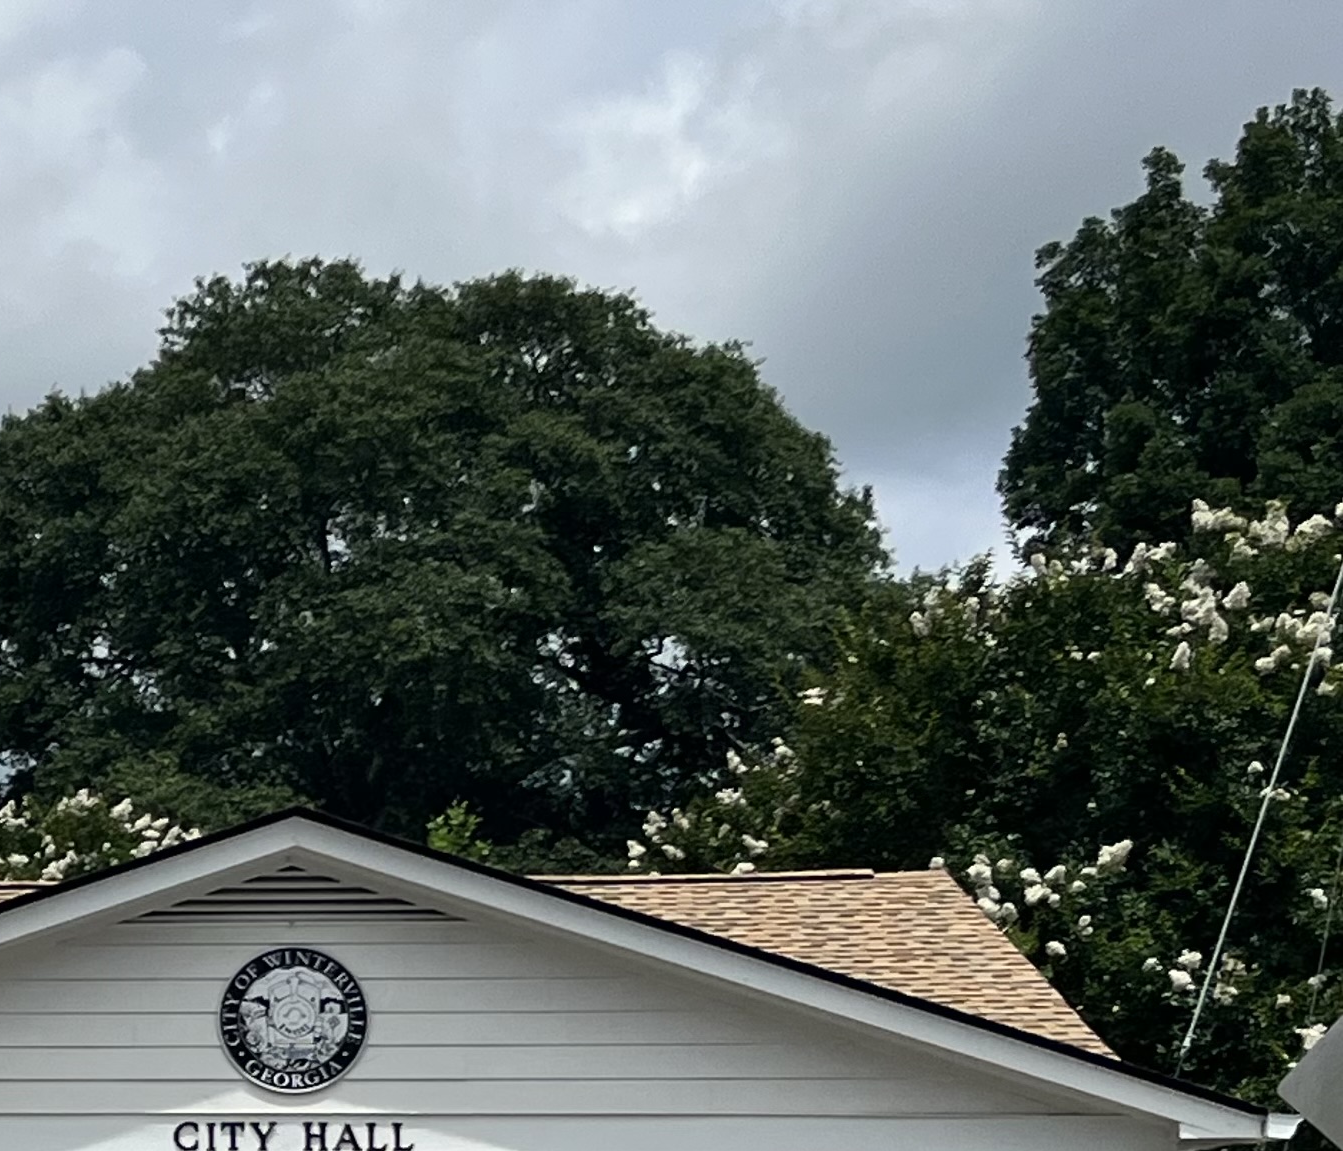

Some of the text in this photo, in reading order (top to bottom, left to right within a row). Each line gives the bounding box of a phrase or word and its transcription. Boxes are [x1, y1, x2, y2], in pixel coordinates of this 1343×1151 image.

[223, 950, 364, 1047] CITY OF WINTERVILLE
[244, 1059, 344, 1088] GEORGIA
[173, 1121, 415, 1151] CITY HALL
